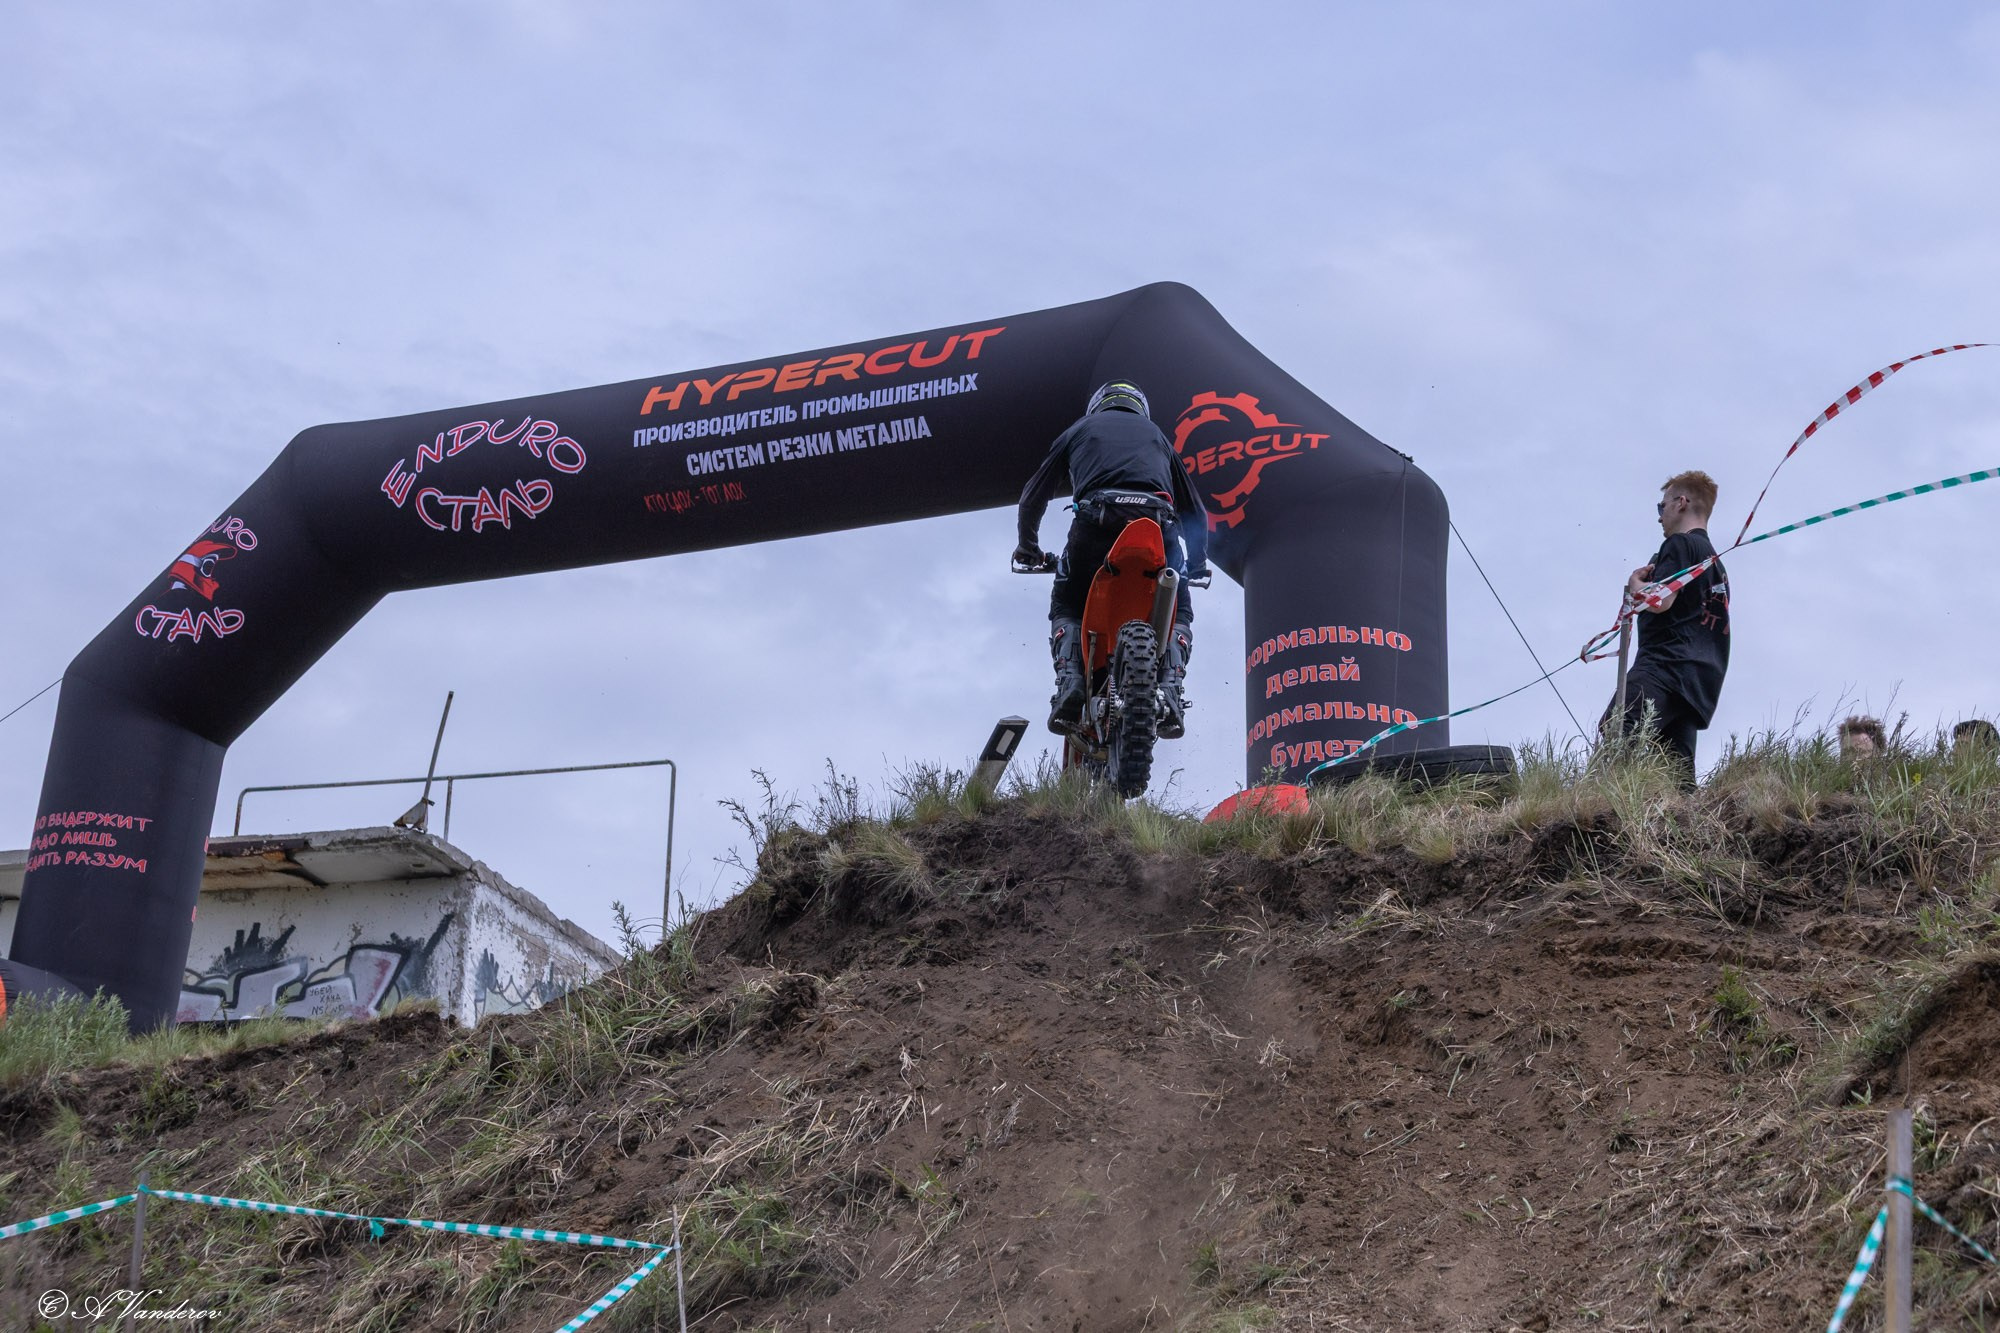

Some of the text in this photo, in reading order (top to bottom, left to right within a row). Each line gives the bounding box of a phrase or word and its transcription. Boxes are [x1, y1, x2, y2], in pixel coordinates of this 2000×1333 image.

[640, 327, 1007, 415] HYPERCUT
[633, 373, 979, 448] ПРОИЗВОДИТЕЛЬ ПРОМЫШЛЕННЫХ
[381, 415, 587, 508] ENDURO
[686, 415, 933, 477] СИСТЕМ РЕЗКИ МЕТАЛЛА
[1182, 433, 1331, 475] PERCUT
[1114, 496, 1148, 505] USWE
[1265, 656, 1361, 699] делай
[1270, 739, 1363, 768] будет
[47, 811, 153, 832] ВЫДЕРЖИТ
[61, 831, 117, 847] ЛИШЬ
[64, 850, 148, 873] РАЗУМ
